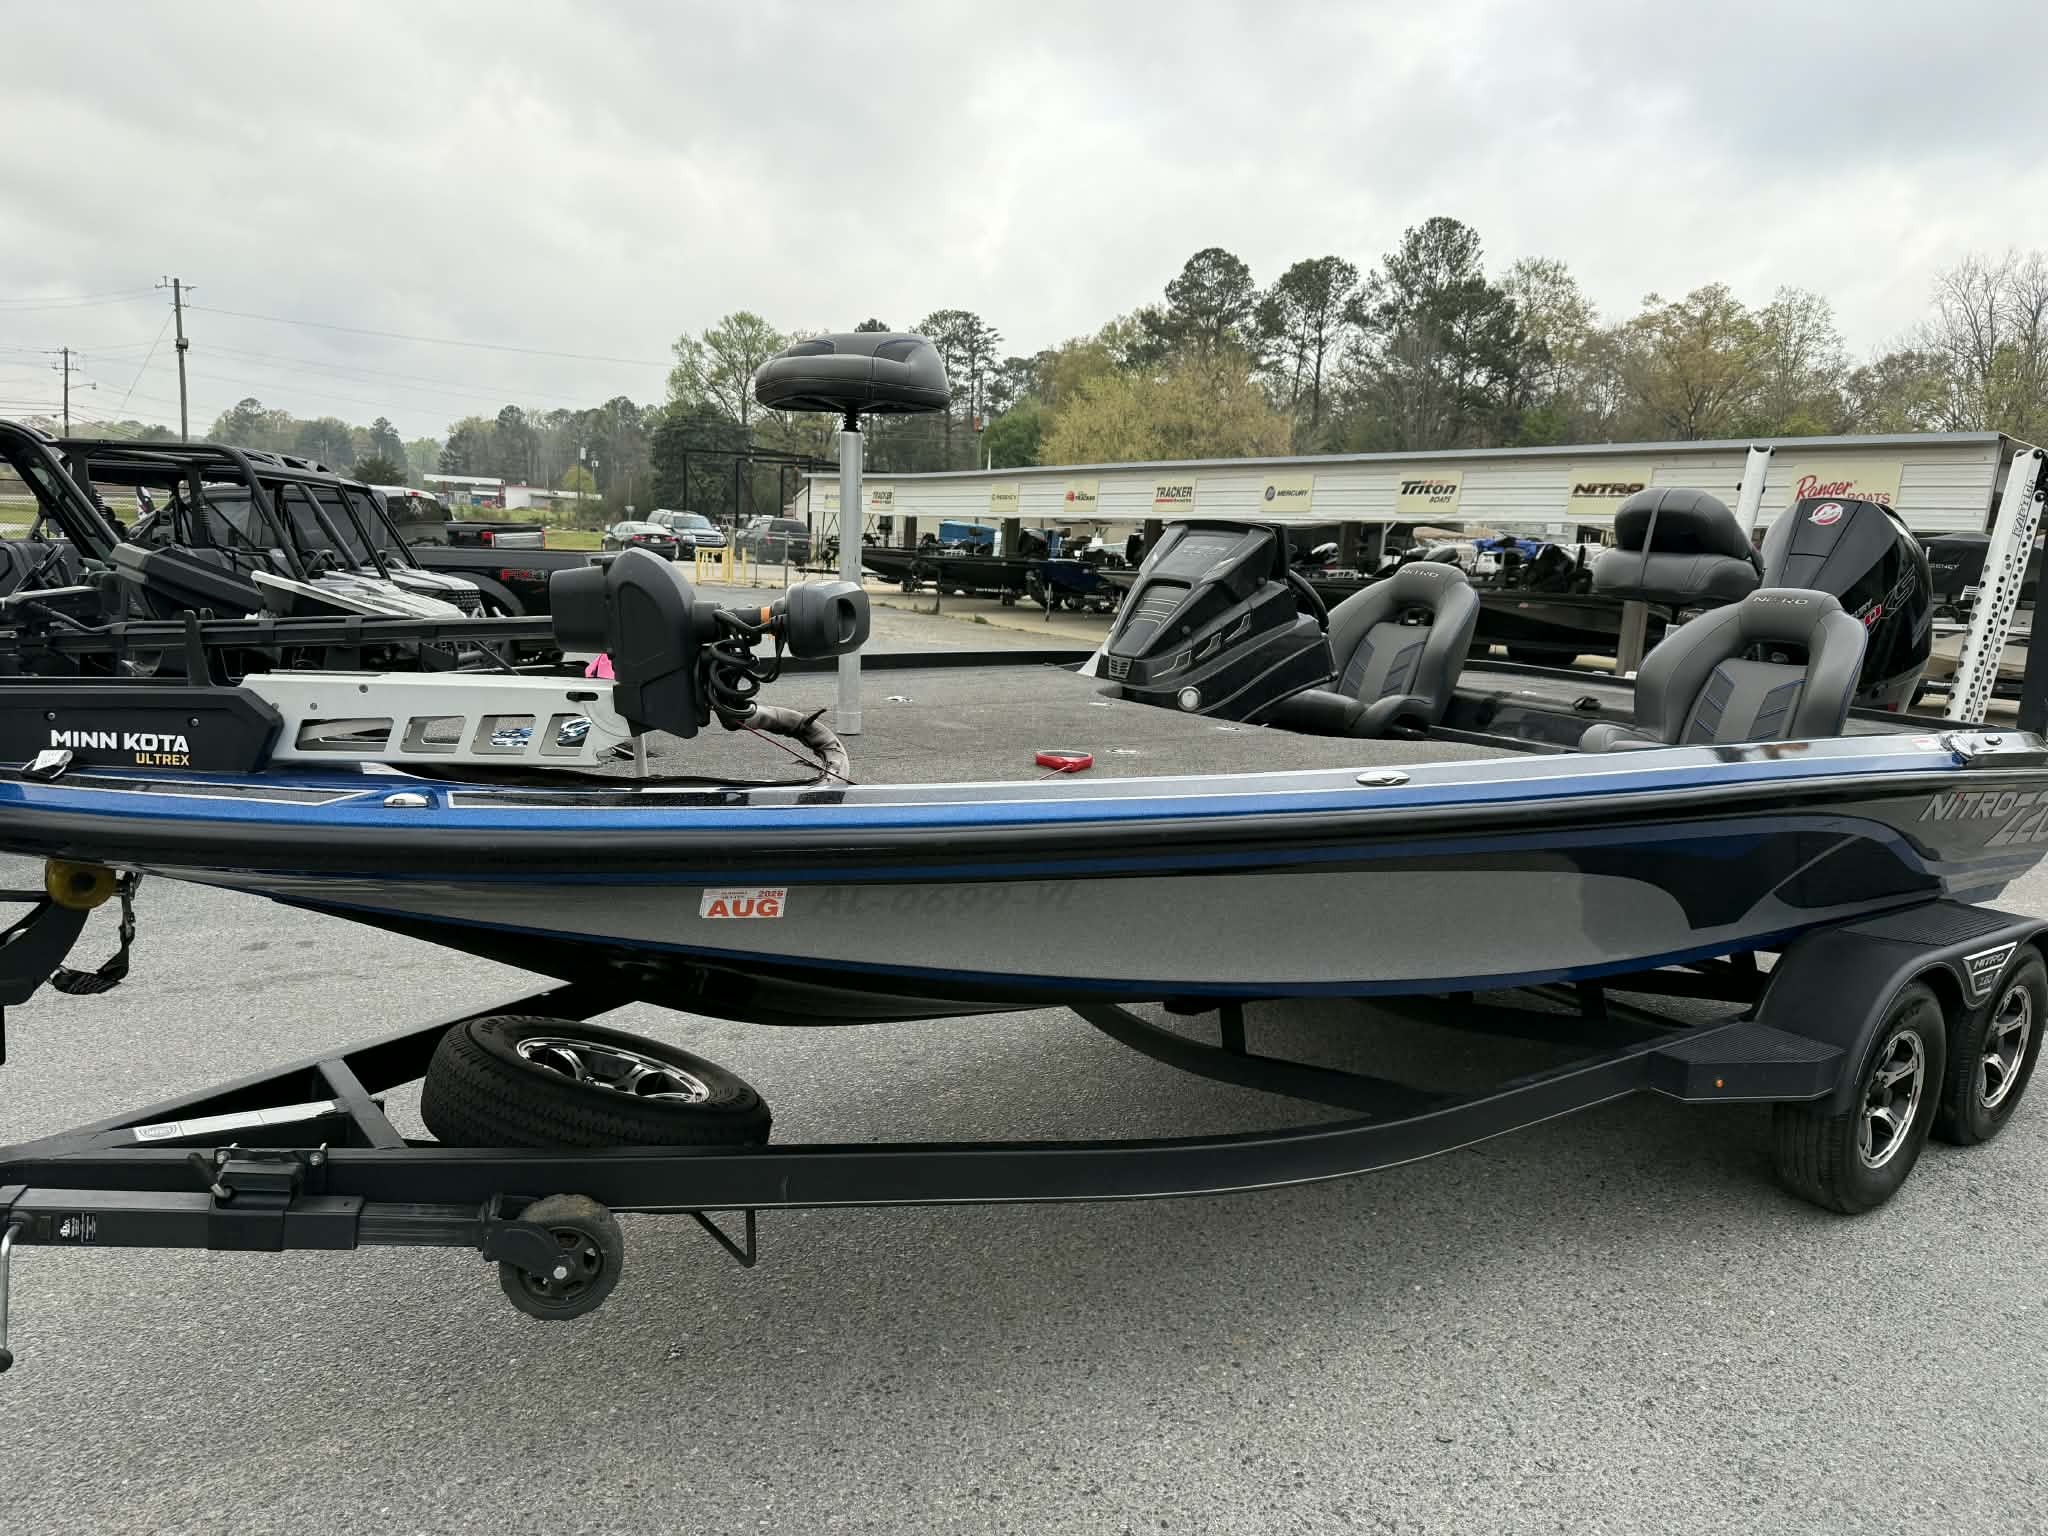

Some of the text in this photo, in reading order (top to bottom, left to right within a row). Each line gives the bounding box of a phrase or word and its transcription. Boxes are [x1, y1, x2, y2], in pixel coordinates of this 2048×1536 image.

[1155, 486, 1193, 498] TRACKER
[1277, 489, 1309, 497] MERCURY
[1400, 480, 1456, 495] Triton
[1572, 482, 1645, 495] NITRO
[1795, 475, 1853, 502] Ranger
[50, 729, 189, 752] MINN KOTA
[135, 752, 190, 766] ULTREX
[707, 898, 779, 917] AUG
[1973, 953, 2006, 970] NITRO
